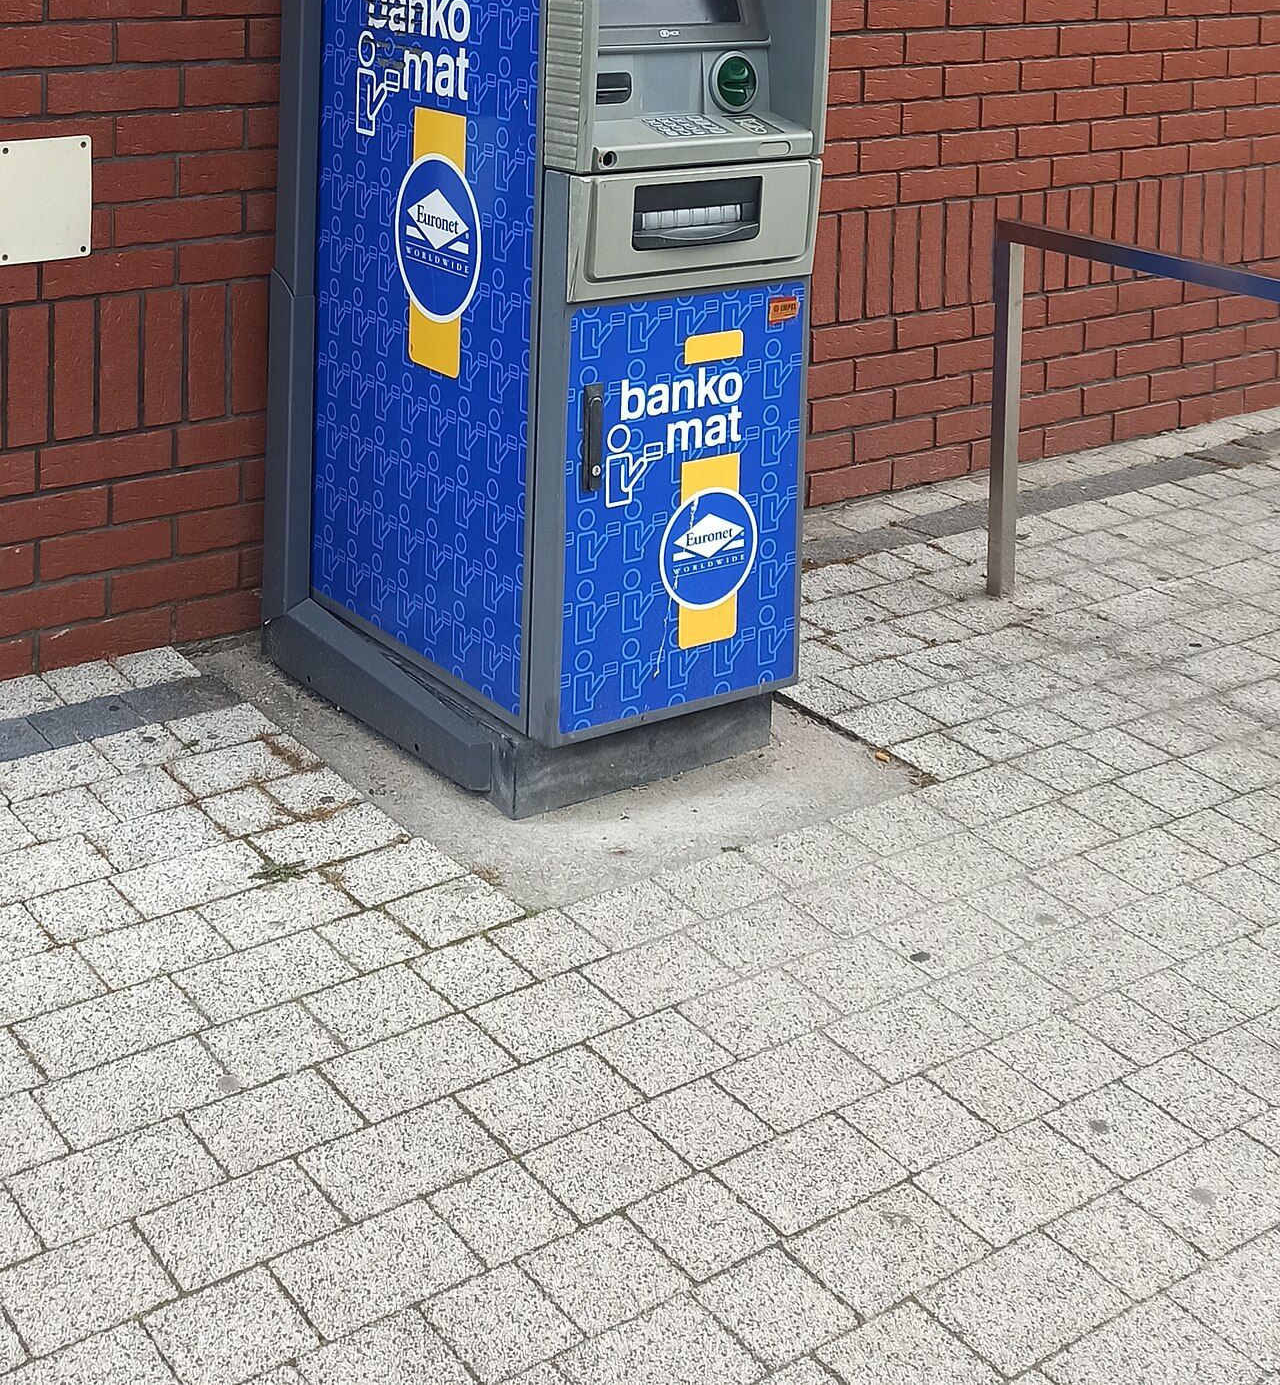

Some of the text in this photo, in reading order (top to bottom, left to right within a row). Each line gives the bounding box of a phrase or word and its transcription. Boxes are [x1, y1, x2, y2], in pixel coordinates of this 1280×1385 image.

[402, 47, 469, 100] mat
[416, 204, 459, 235] Euronet
[405, 246, 470, 274] WORLDWIDE
[620, 367, 743, 421] banko
[666, 409, 742, 454] mat
[685, 528, 733, 547] Euronet
[672, 554, 745, 574] WORLDWIDE
